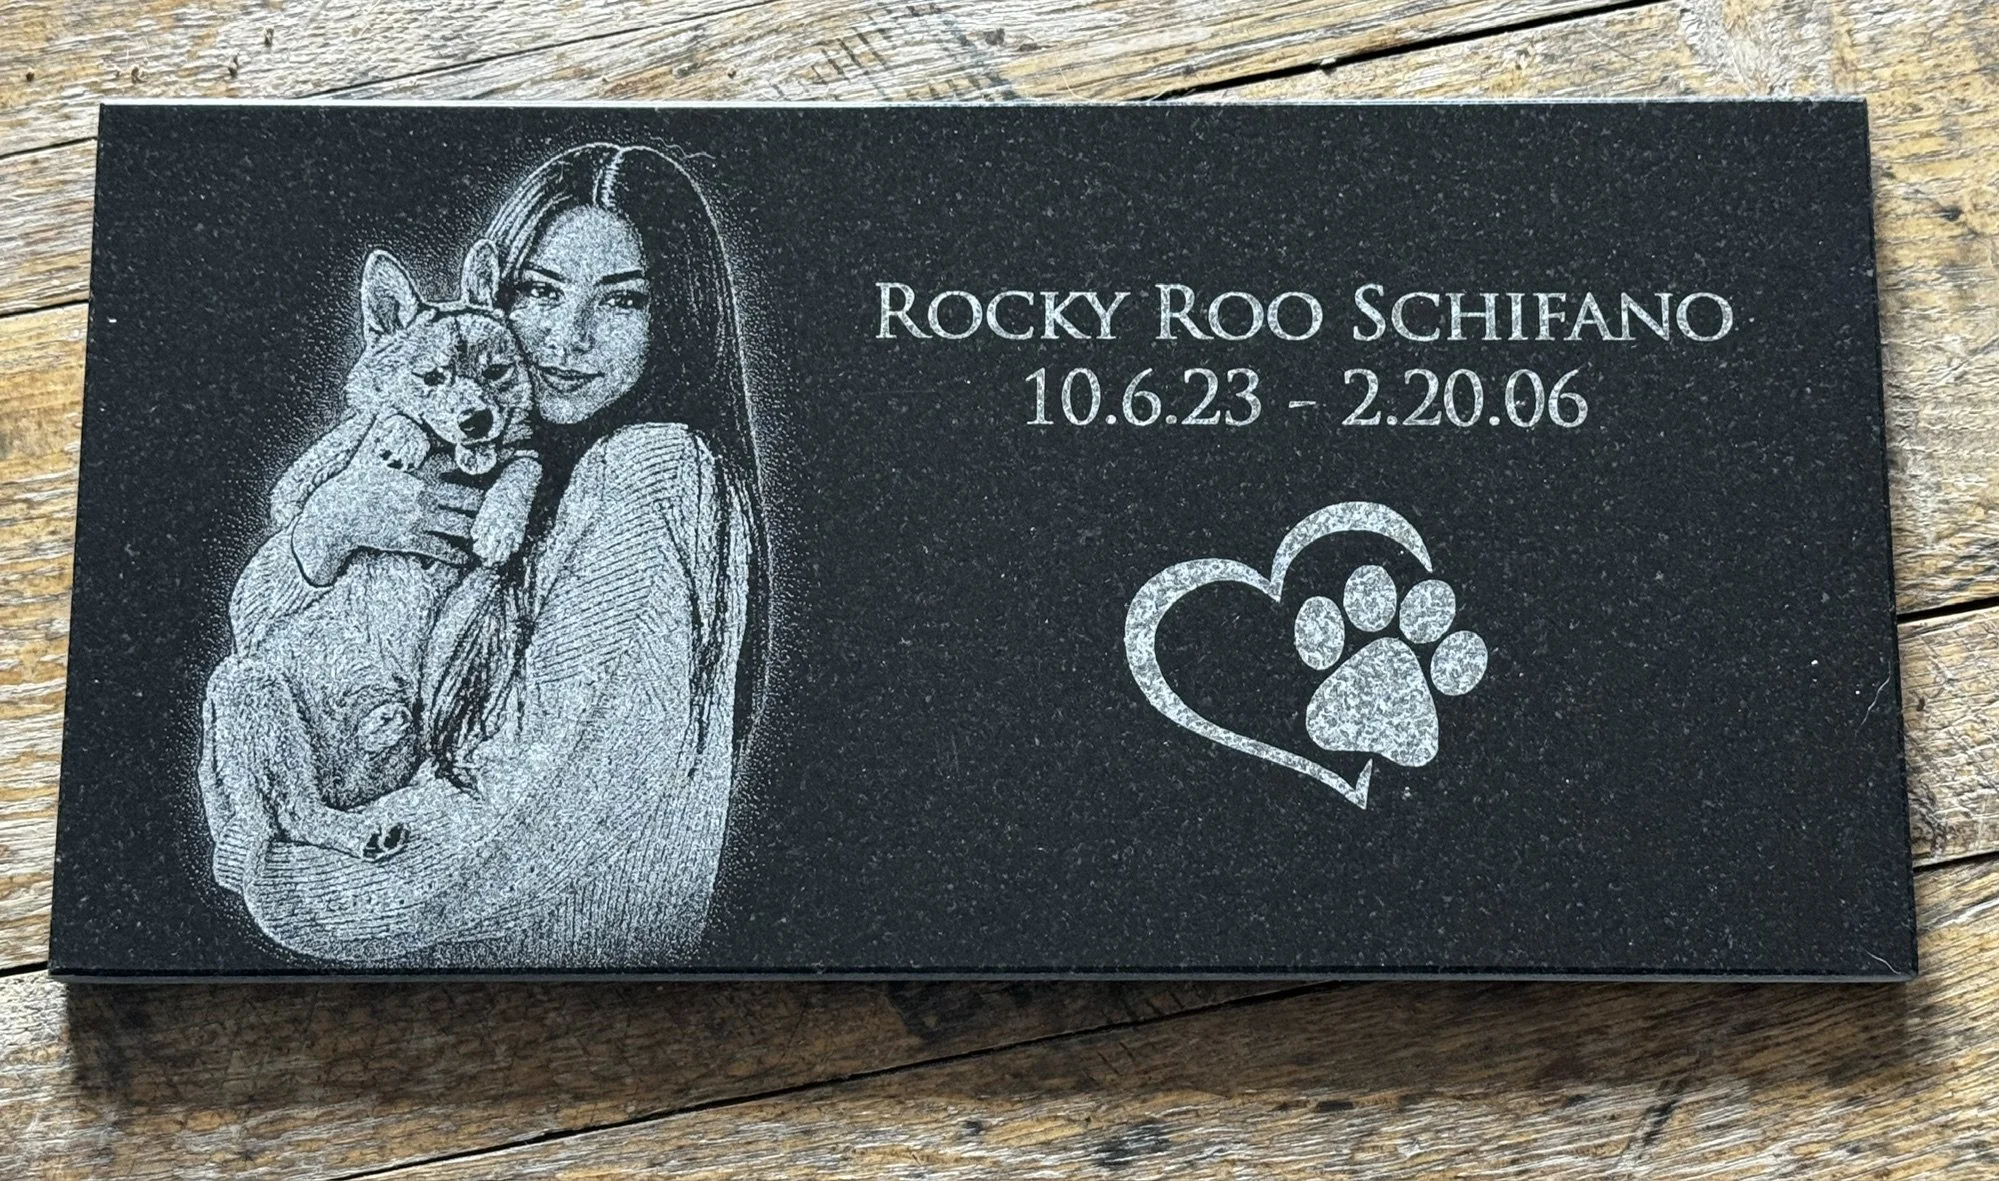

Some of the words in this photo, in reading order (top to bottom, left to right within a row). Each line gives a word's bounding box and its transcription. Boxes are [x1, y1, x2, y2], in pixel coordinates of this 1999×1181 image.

[875, 281, 1132, 341] ROCKY
[1154, 283, 1324, 341] ROO
[1352, 282, 1734, 343] SCHIFANO
[1026, 367, 1262, 427] 10.6.23
[1342, 368, 1589, 429] 2.20.06
